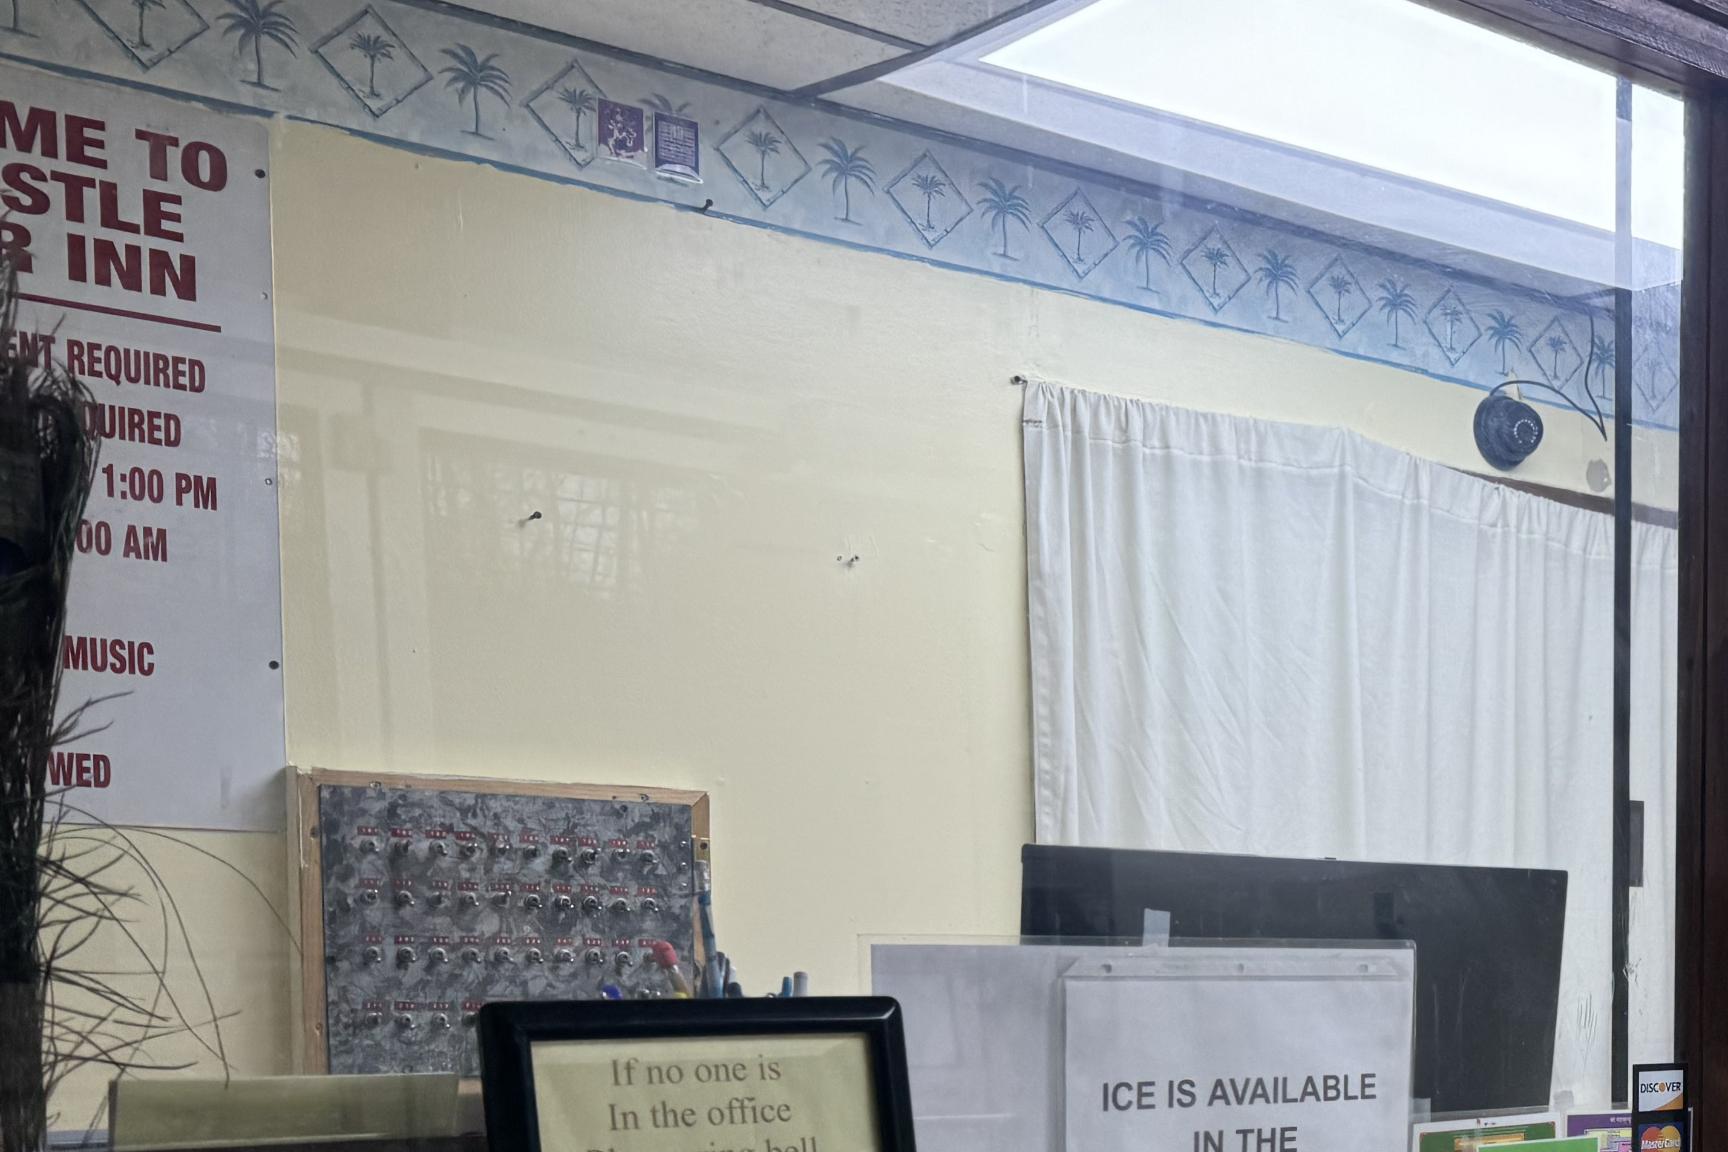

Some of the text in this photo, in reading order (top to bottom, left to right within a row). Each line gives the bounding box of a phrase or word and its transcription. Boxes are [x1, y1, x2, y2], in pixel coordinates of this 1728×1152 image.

[135, 128, 228, 192] TO
[67, 232, 196, 302] INN
[66, 338, 206, 394] REQUIRED
[82, 400, 182, 448] QUIRED
[101, 463, 218, 511] 1:00 PM
[122, 524, 168, 563] AM
[63, 634, 155, 677] MUSIC
[611, 1054, 782, 1087] If no one is
[1102, 1073, 1377, 1111] ICE IS AVAILABLE
[1640, 1081, 1682, 1094] DISCOVER
[608, 1097, 793, 1131] In the office
